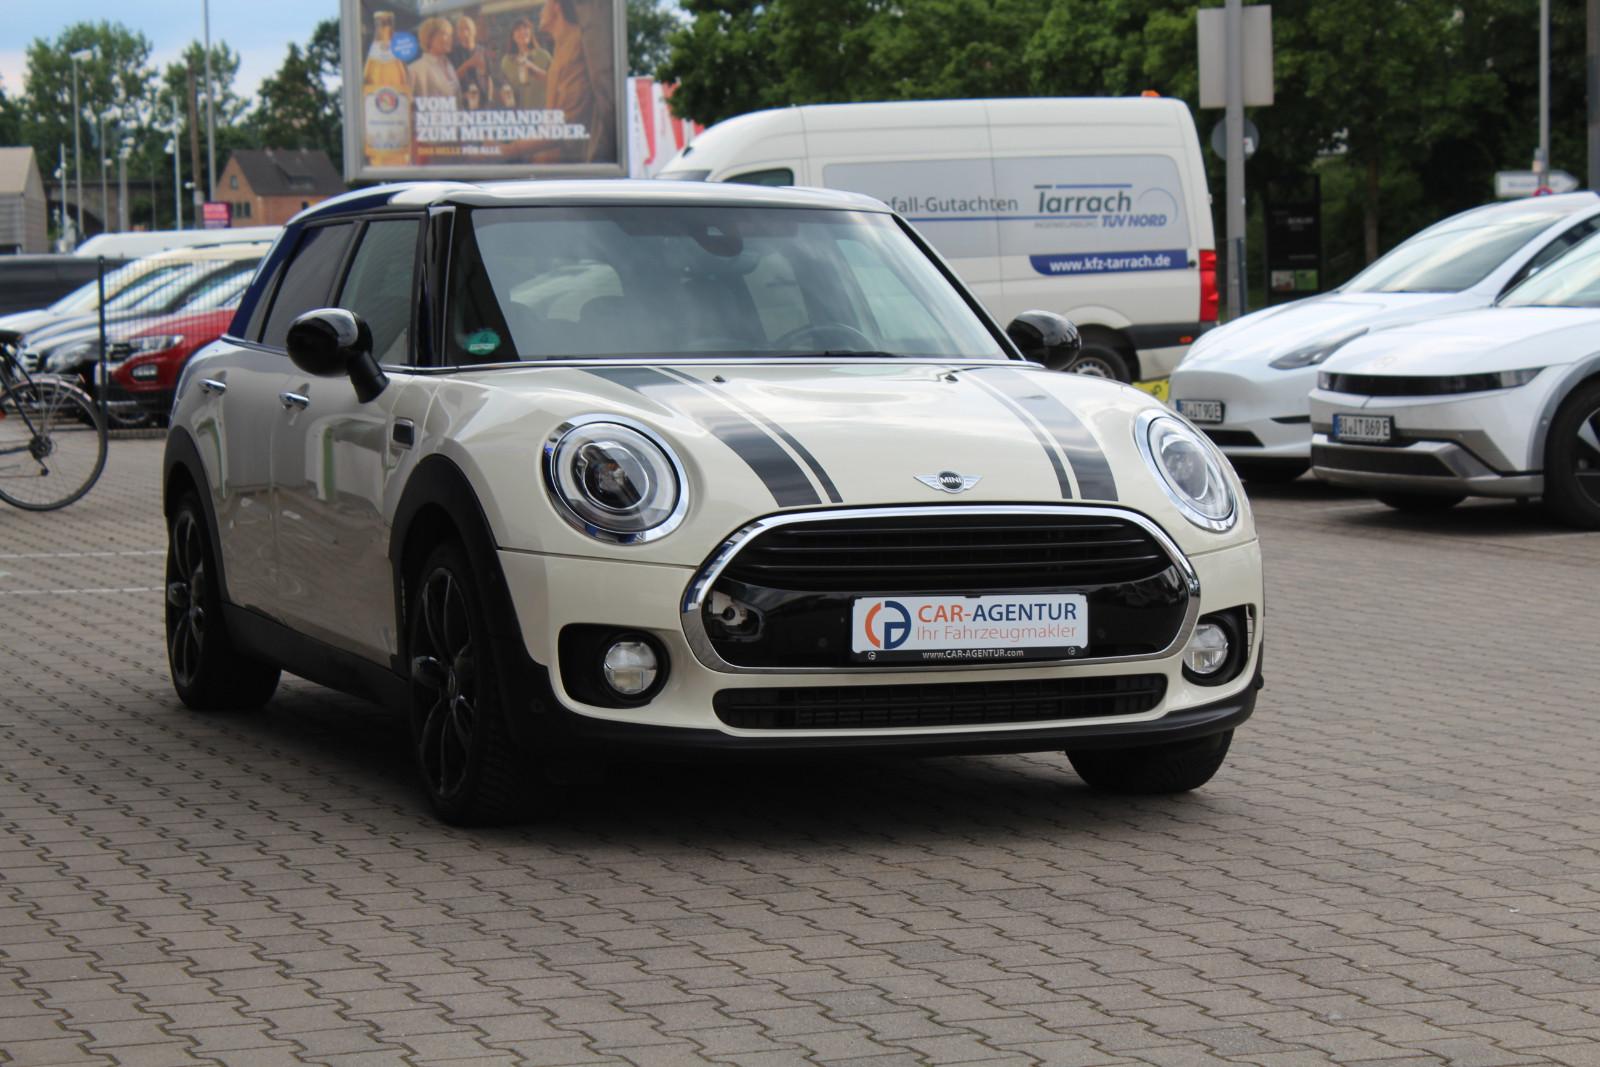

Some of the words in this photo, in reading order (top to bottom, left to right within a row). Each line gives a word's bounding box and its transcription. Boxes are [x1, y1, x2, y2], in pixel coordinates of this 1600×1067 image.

[416, 96, 457, 112] VOM
[416, 109, 565, 127] NEBENEINANDER
[416, 125, 457, 141] ZUM
[460, 123, 591, 141] MITEINANDER.
[1034, 184, 1132, 214] Tarrach
[1128, 213, 1167, 227] NORD
[1050, 254, 1171, 273] www.kfz-tarrach.de
[939, 475, 962, 485] MINI
[918, 602, 1077, 623] CAR-AGENTUR
[917, 625, 938, 641] Ihr
[944, 623, 1076, 643] Fahrzeugmakler
[922, 648, 1024, 659] www.CAR-AGENTUR.com
